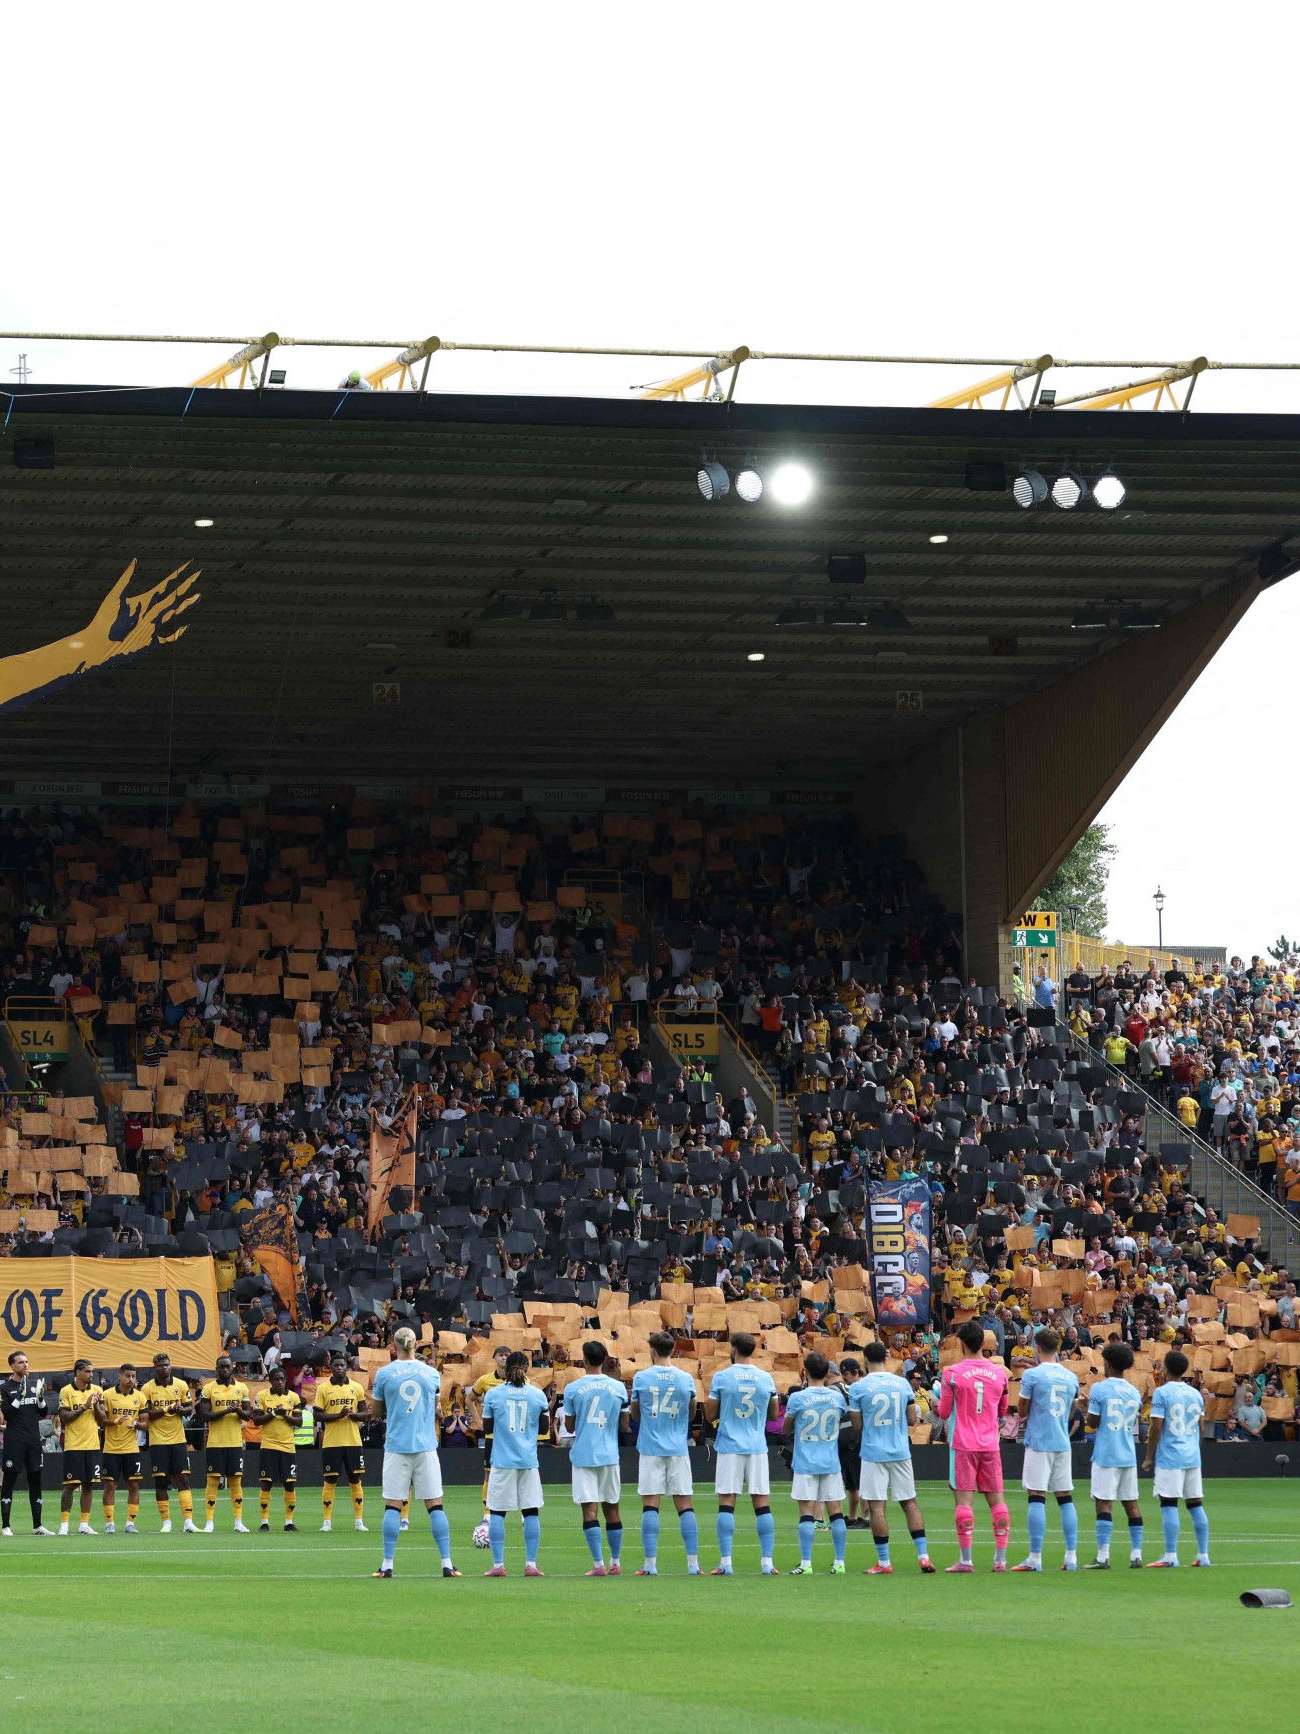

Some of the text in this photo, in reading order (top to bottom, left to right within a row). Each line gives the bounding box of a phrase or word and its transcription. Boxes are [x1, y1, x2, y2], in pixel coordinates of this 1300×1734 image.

[374, 684, 398, 703] 24
[898, 692, 920, 710] 25
[33, 784, 65, 793] FOSUN
[118, 785, 150, 794] FOSUN
[1044, 914, 1051, 927] 1
[20, 1030, 54, 1046] SL4
[672, 1032, 705, 1049] SL5
[0, 1288, 64, 1343] OF
[75, 1288, 206, 1342] GOLD
[390, 1367, 430, 1379] HAALAND
[657, 1372, 675, 1381] NICO
[962, 1368, 997, 1380] TRAFFORD
[399, 1379, 422, 1414] 9
[507, 1387, 529, 1396] DOKU
[974, 1381, 984, 1414] 1
[153, 1399, 179, 1407] DEBET
[330, 1398, 355, 1407] DEBET
[649, 1386, 680, 1419] 14
[734, 1386, 757, 1419] 3
[802, 1396, 839, 1408] BERNARDO
[871, 1391, 901, 1427] 21
[1048, 1384, 1068, 1418] 5
[112, 1407, 138, 1416] DEBET
[506, 1399, 528, 1434] 11
[587, 1396, 607, 1429] 4
[1106, 1398, 1139, 1432] 52
[1169, 1403, 1201, 1437] 82
[801, 1408, 840, 1442] 20
[135, 1462, 141, 1472] 7
[360, 1455, 365, 1466] 5
